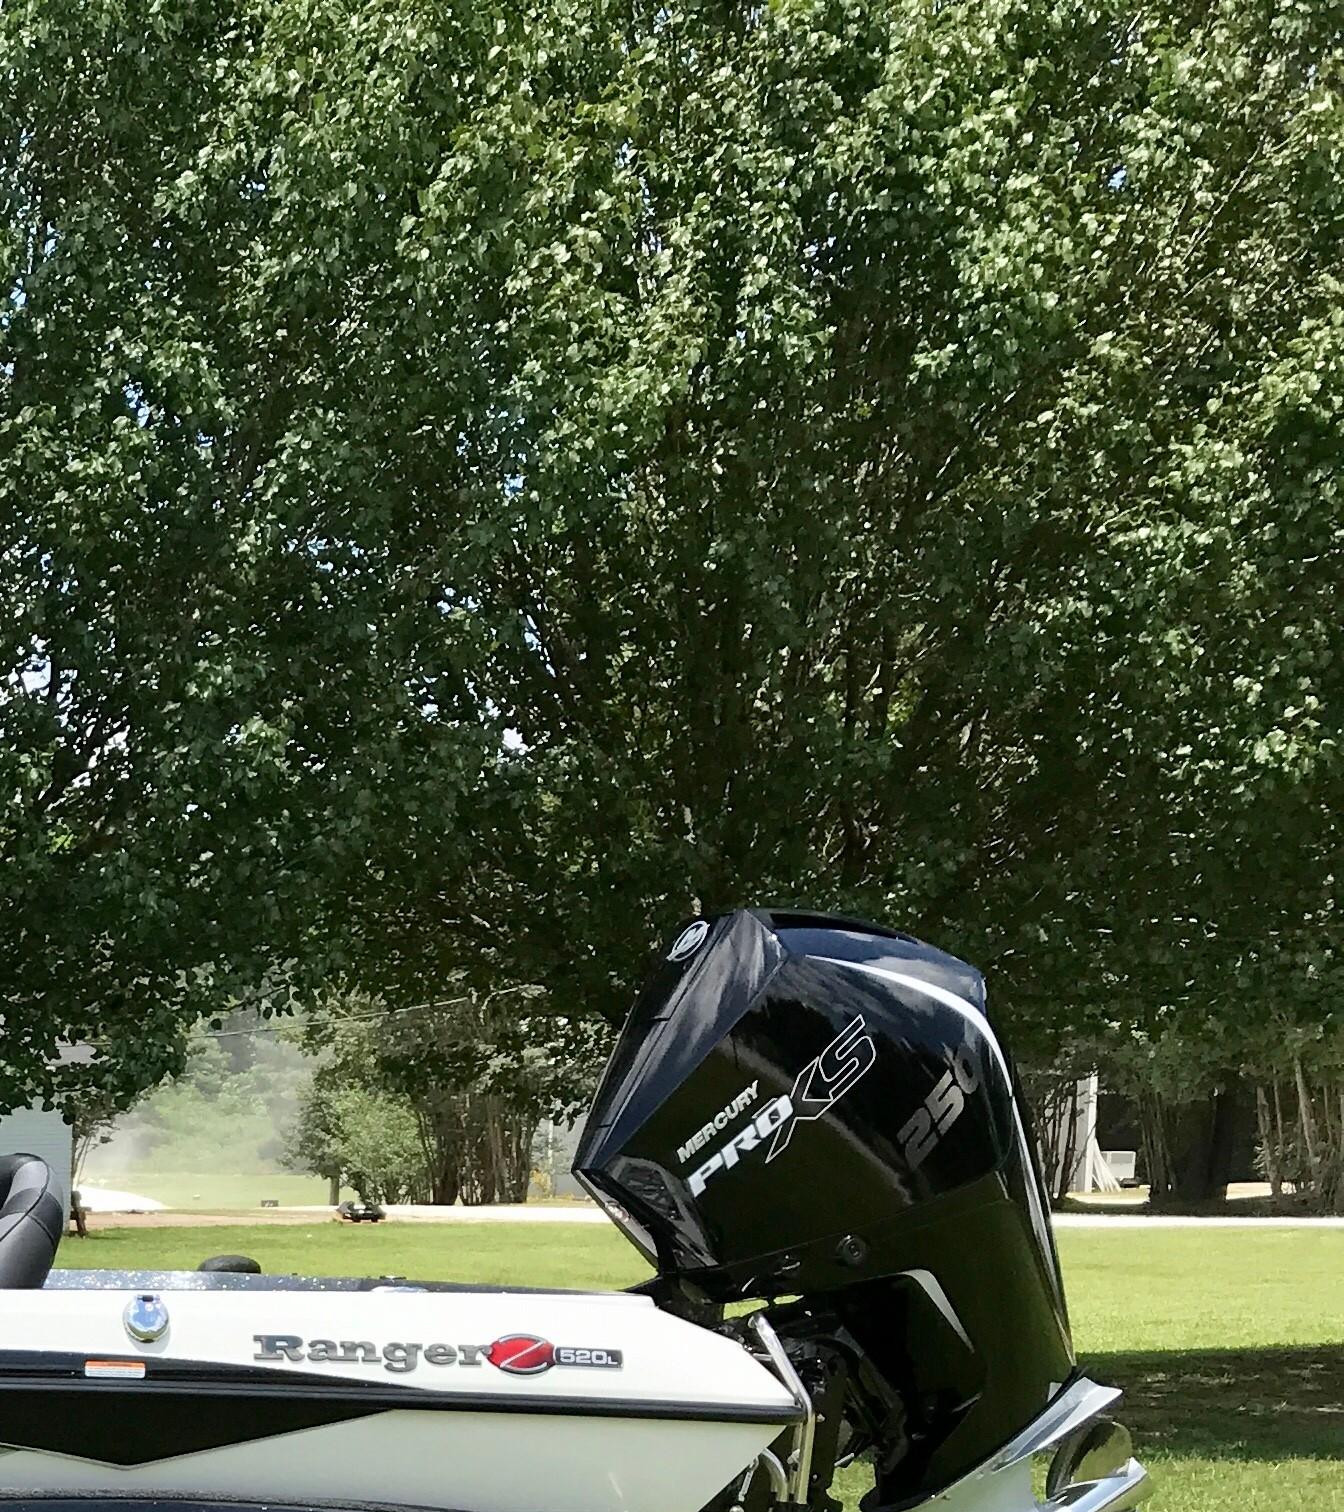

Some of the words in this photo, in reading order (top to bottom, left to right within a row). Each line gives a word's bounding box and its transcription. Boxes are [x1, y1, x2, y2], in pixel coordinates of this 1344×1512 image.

[676, 1079, 760, 1164] MERCURY
[896, 1042, 981, 1170] 250
[252, 1334, 493, 1373] Ranger
[559, 1348, 620, 1367] 520L
